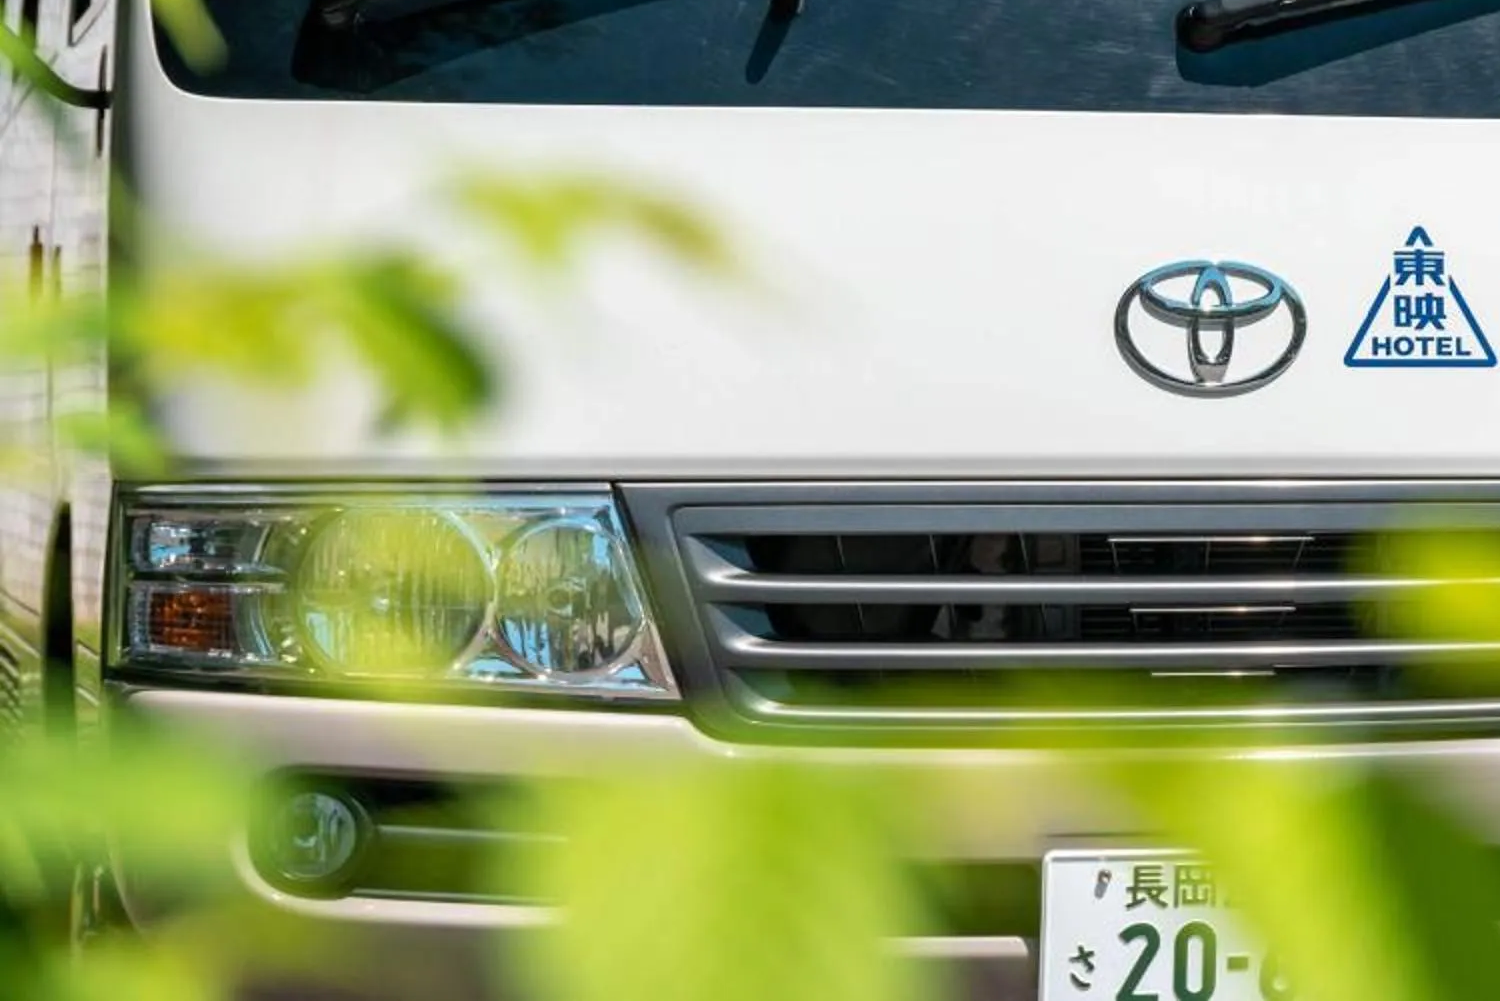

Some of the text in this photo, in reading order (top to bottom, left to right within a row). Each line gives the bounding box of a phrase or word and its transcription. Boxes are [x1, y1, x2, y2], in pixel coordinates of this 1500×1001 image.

[1393, 249, 1446, 330] 東映
[1371, 336, 1472, 356] HOTEL
[1068, 944, 1096, 990] さ
